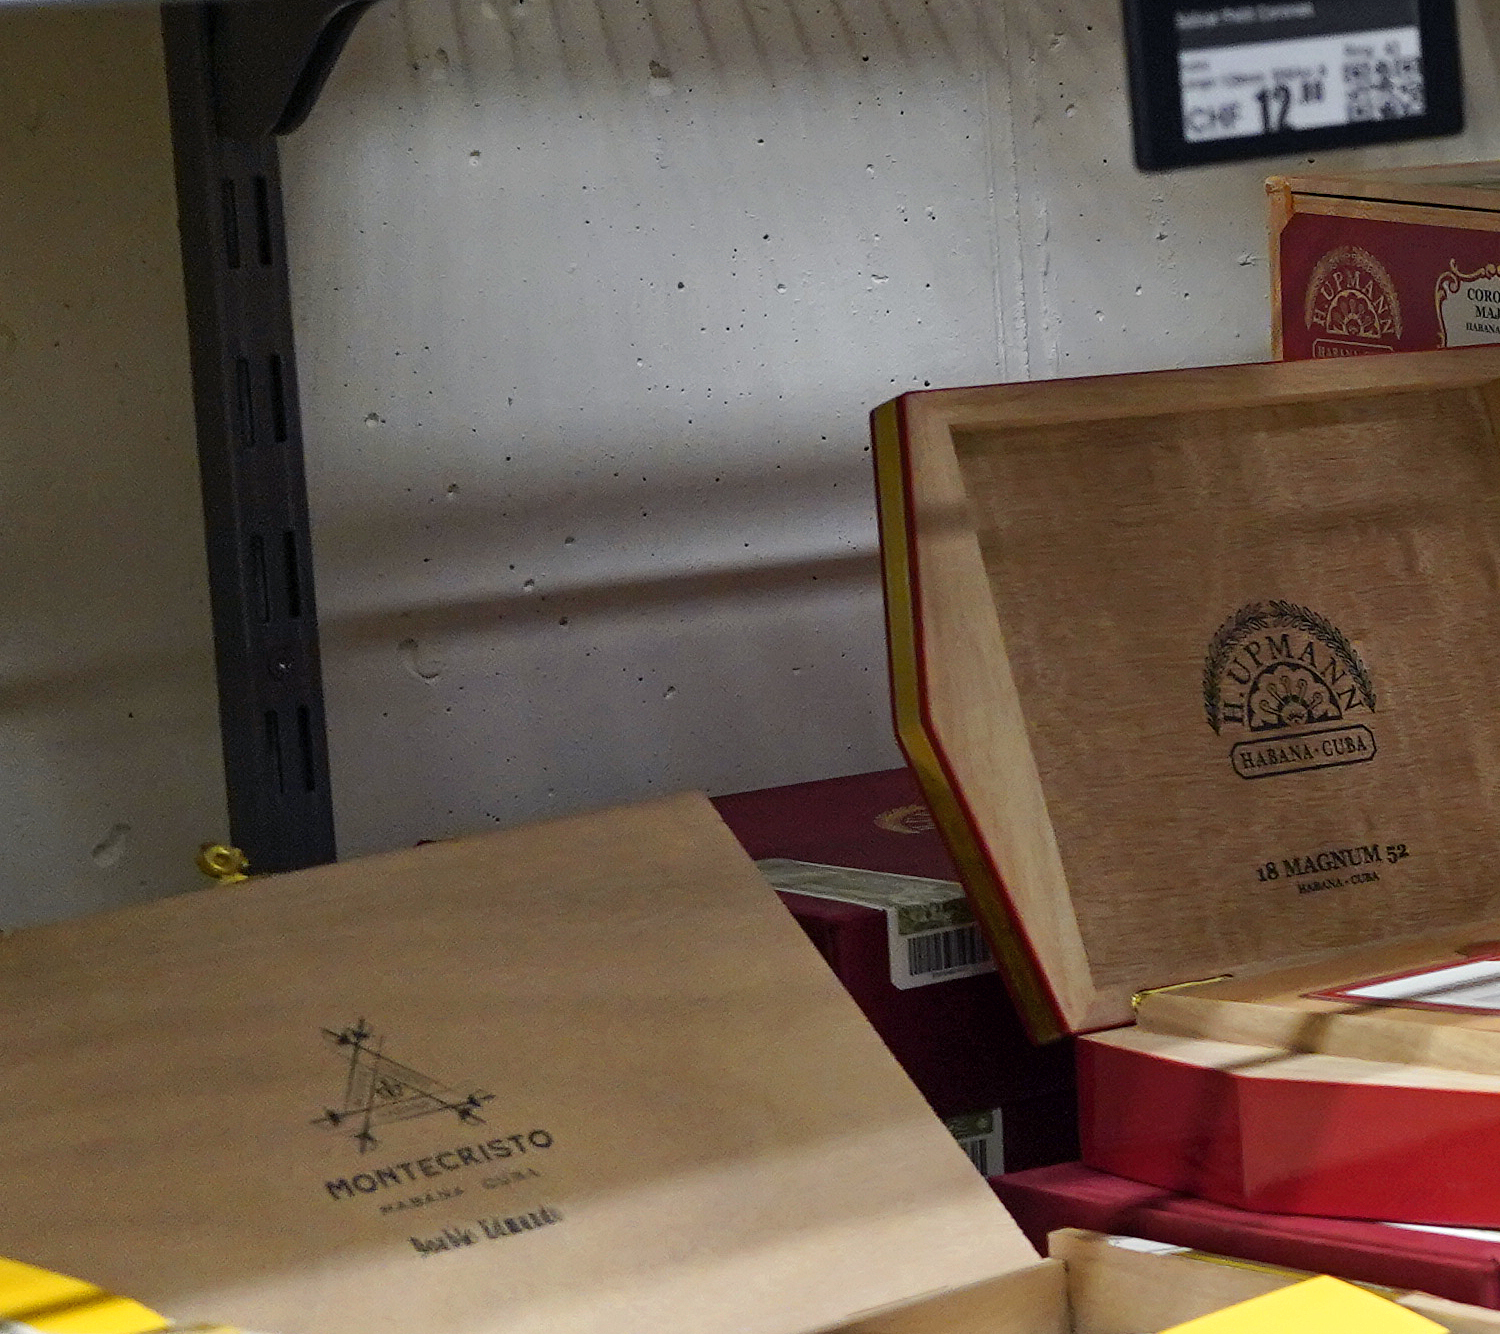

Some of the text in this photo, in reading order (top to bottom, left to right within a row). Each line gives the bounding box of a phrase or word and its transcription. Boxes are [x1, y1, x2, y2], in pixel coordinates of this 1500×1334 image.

[1240, 736, 1367, 768] HABANA CUBA
[1257, 844, 1409, 882] 18 MAGNUM 52
[325, 1127, 555, 1201] MONTECRISTO
